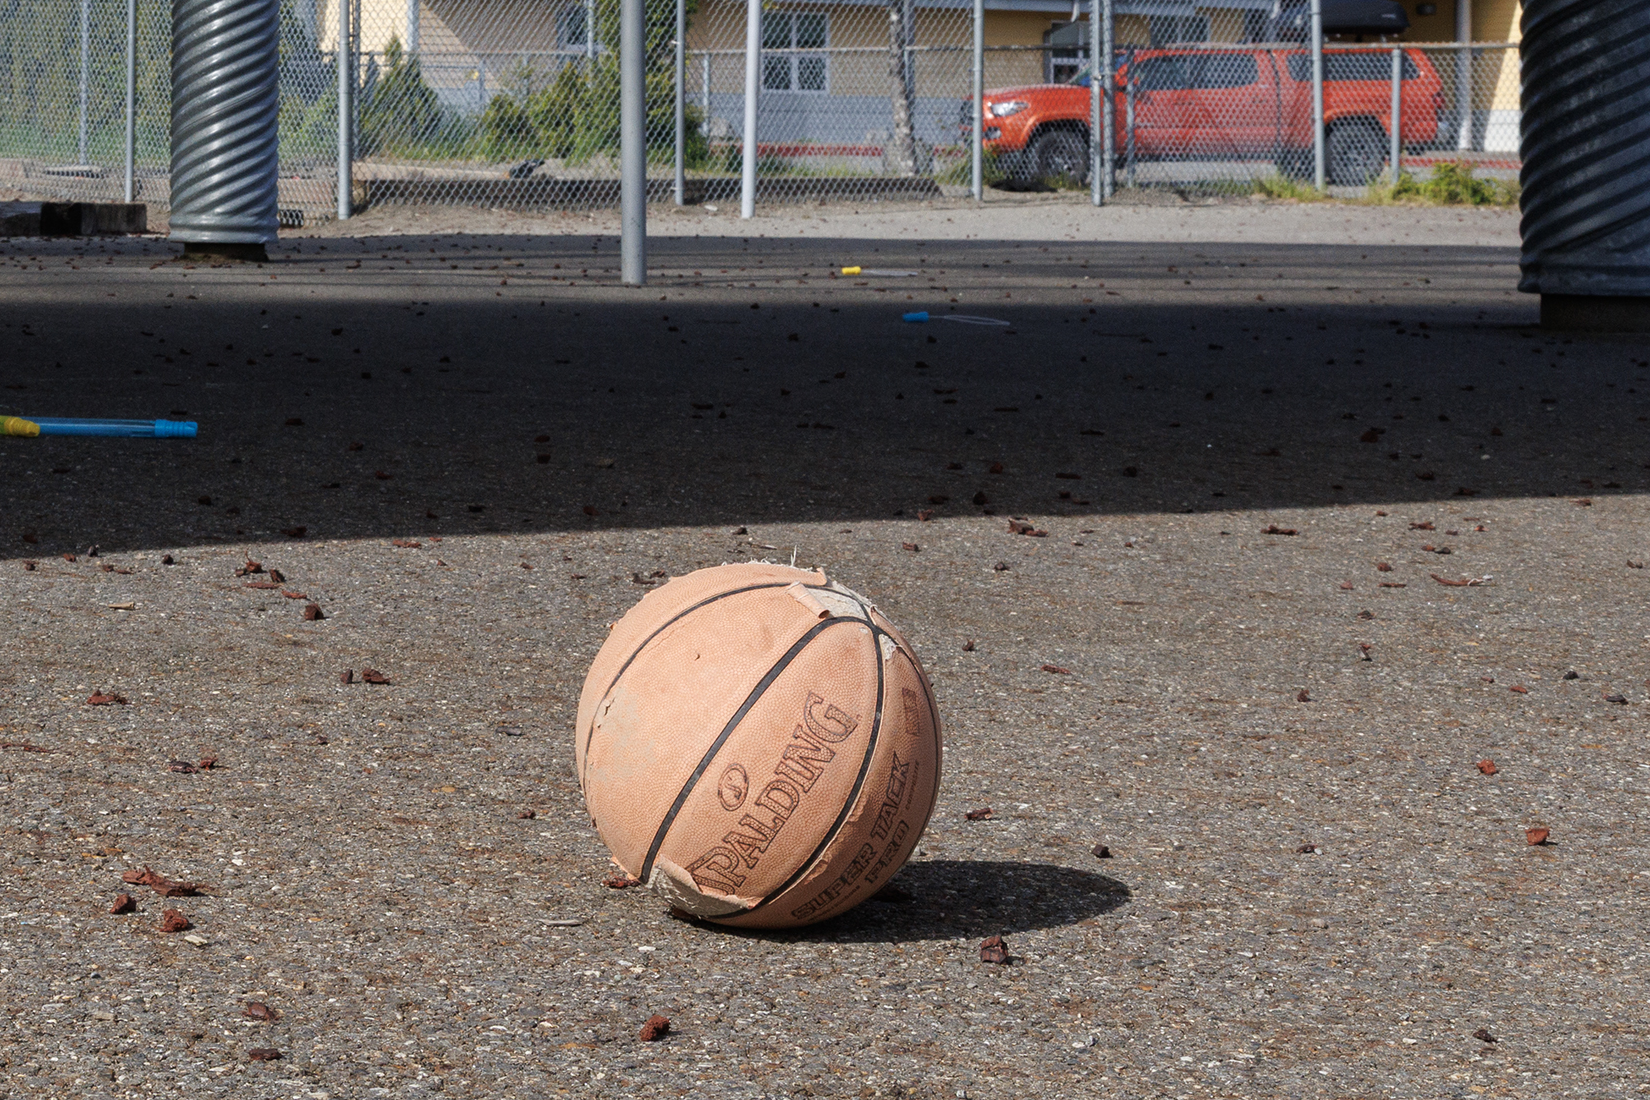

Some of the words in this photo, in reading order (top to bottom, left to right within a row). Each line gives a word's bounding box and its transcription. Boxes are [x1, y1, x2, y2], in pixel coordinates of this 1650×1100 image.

[790, 842, 878, 920] SUPER
[869, 750, 910, 841] TACK
[864, 819, 910, 884] PRO
